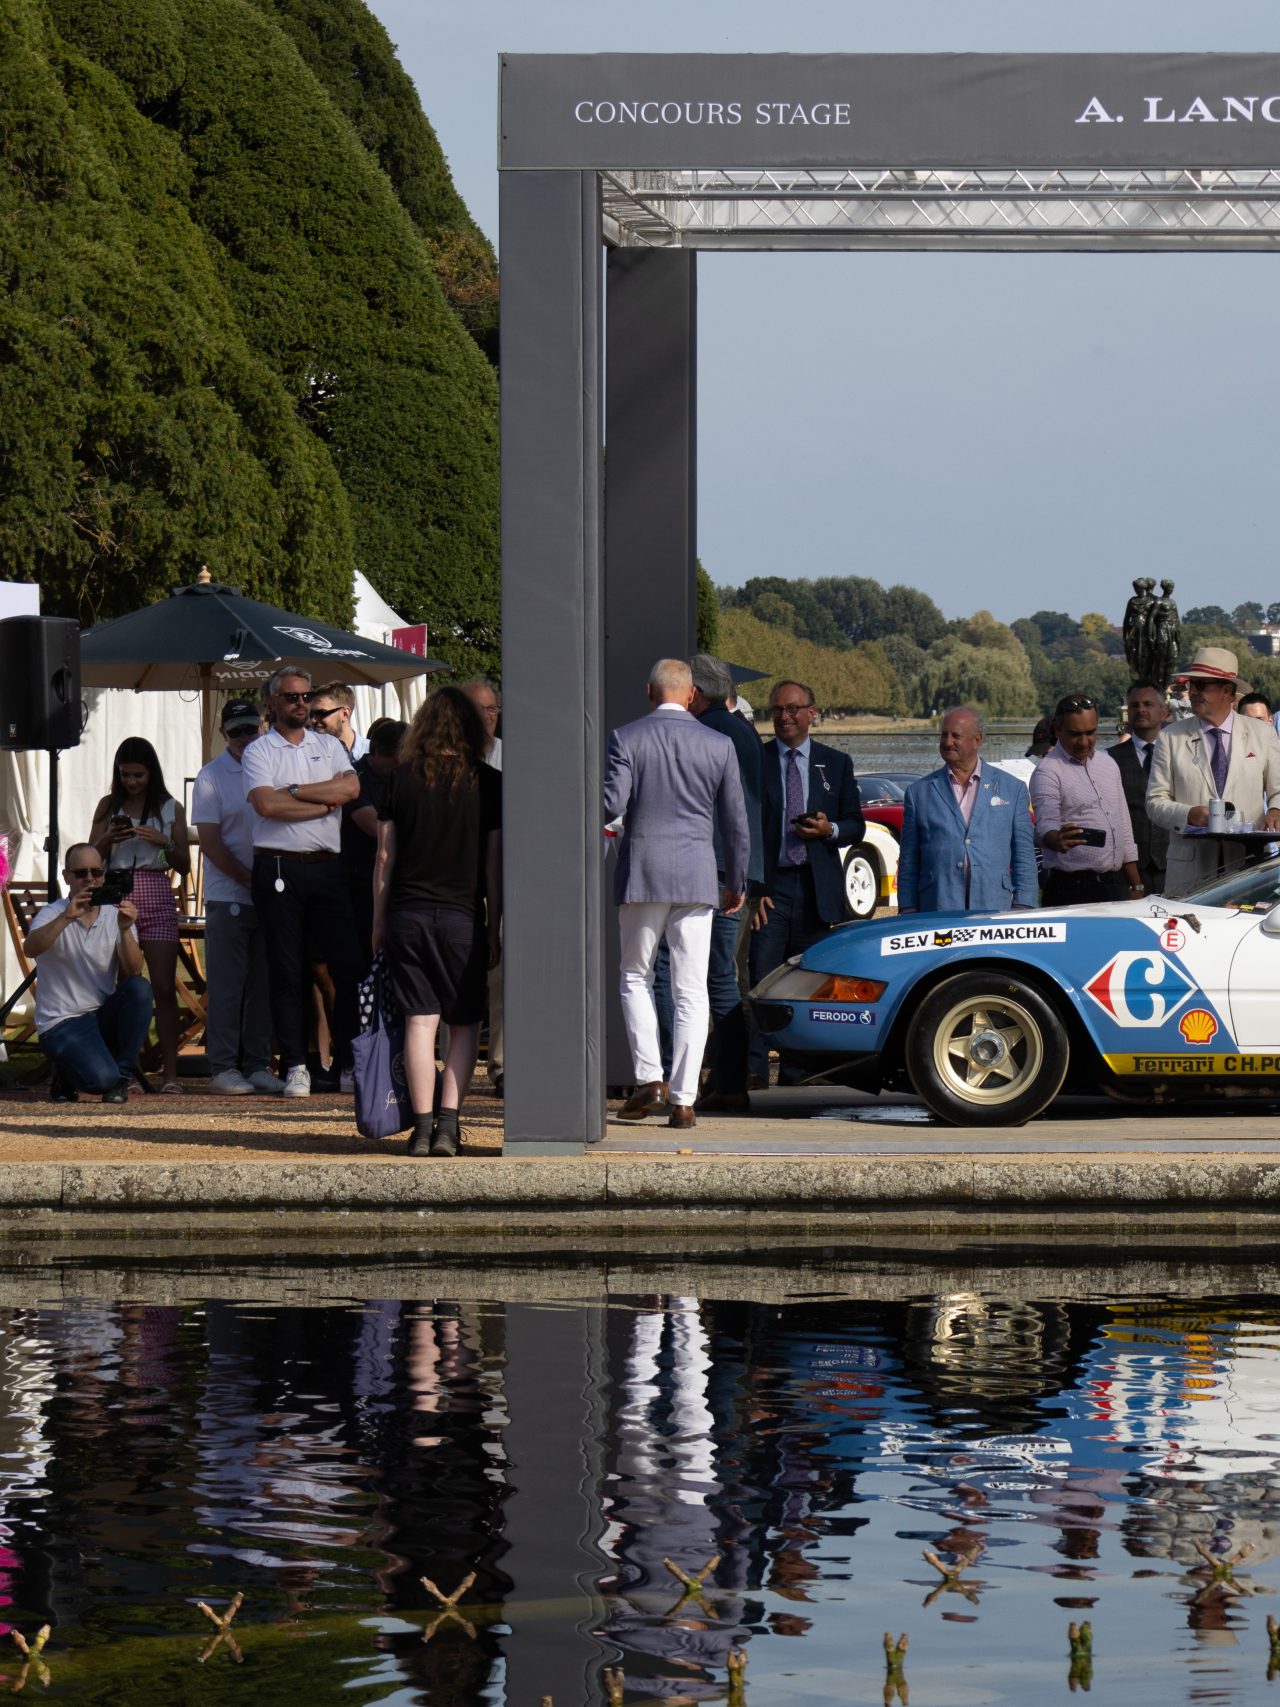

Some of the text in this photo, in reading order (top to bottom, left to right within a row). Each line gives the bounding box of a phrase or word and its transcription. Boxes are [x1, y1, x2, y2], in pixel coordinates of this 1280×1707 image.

[574, 101, 851, 125] CONCOURS STAGE
[1074, 96, 1124, 123] A.
[979, 926, 1057, 941] MARCHAL
[1166, 932, 1179, 947] E
[812, 1010, 857, 1022] FERODO
[1132, 1056, 1215, 1073] Ferrari
